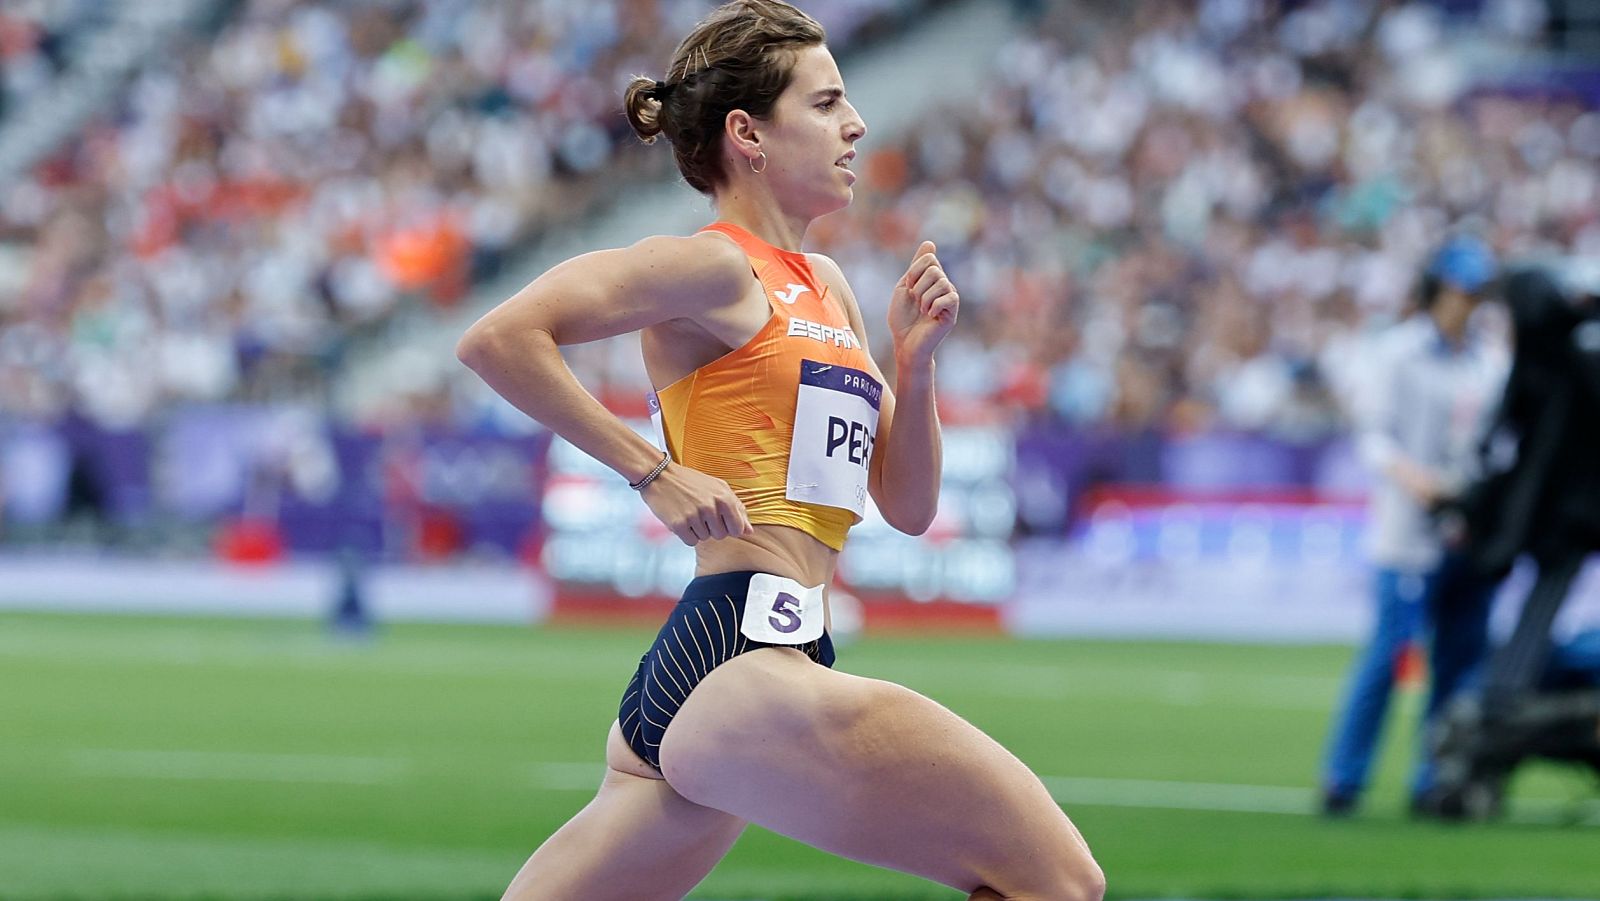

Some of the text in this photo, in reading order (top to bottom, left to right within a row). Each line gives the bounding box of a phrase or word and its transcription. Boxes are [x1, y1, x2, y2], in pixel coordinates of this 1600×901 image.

[844, 374, 870, 393] PARIS
[826, 415, 875, 471] PER
[768, 591, 802, 634] 5
